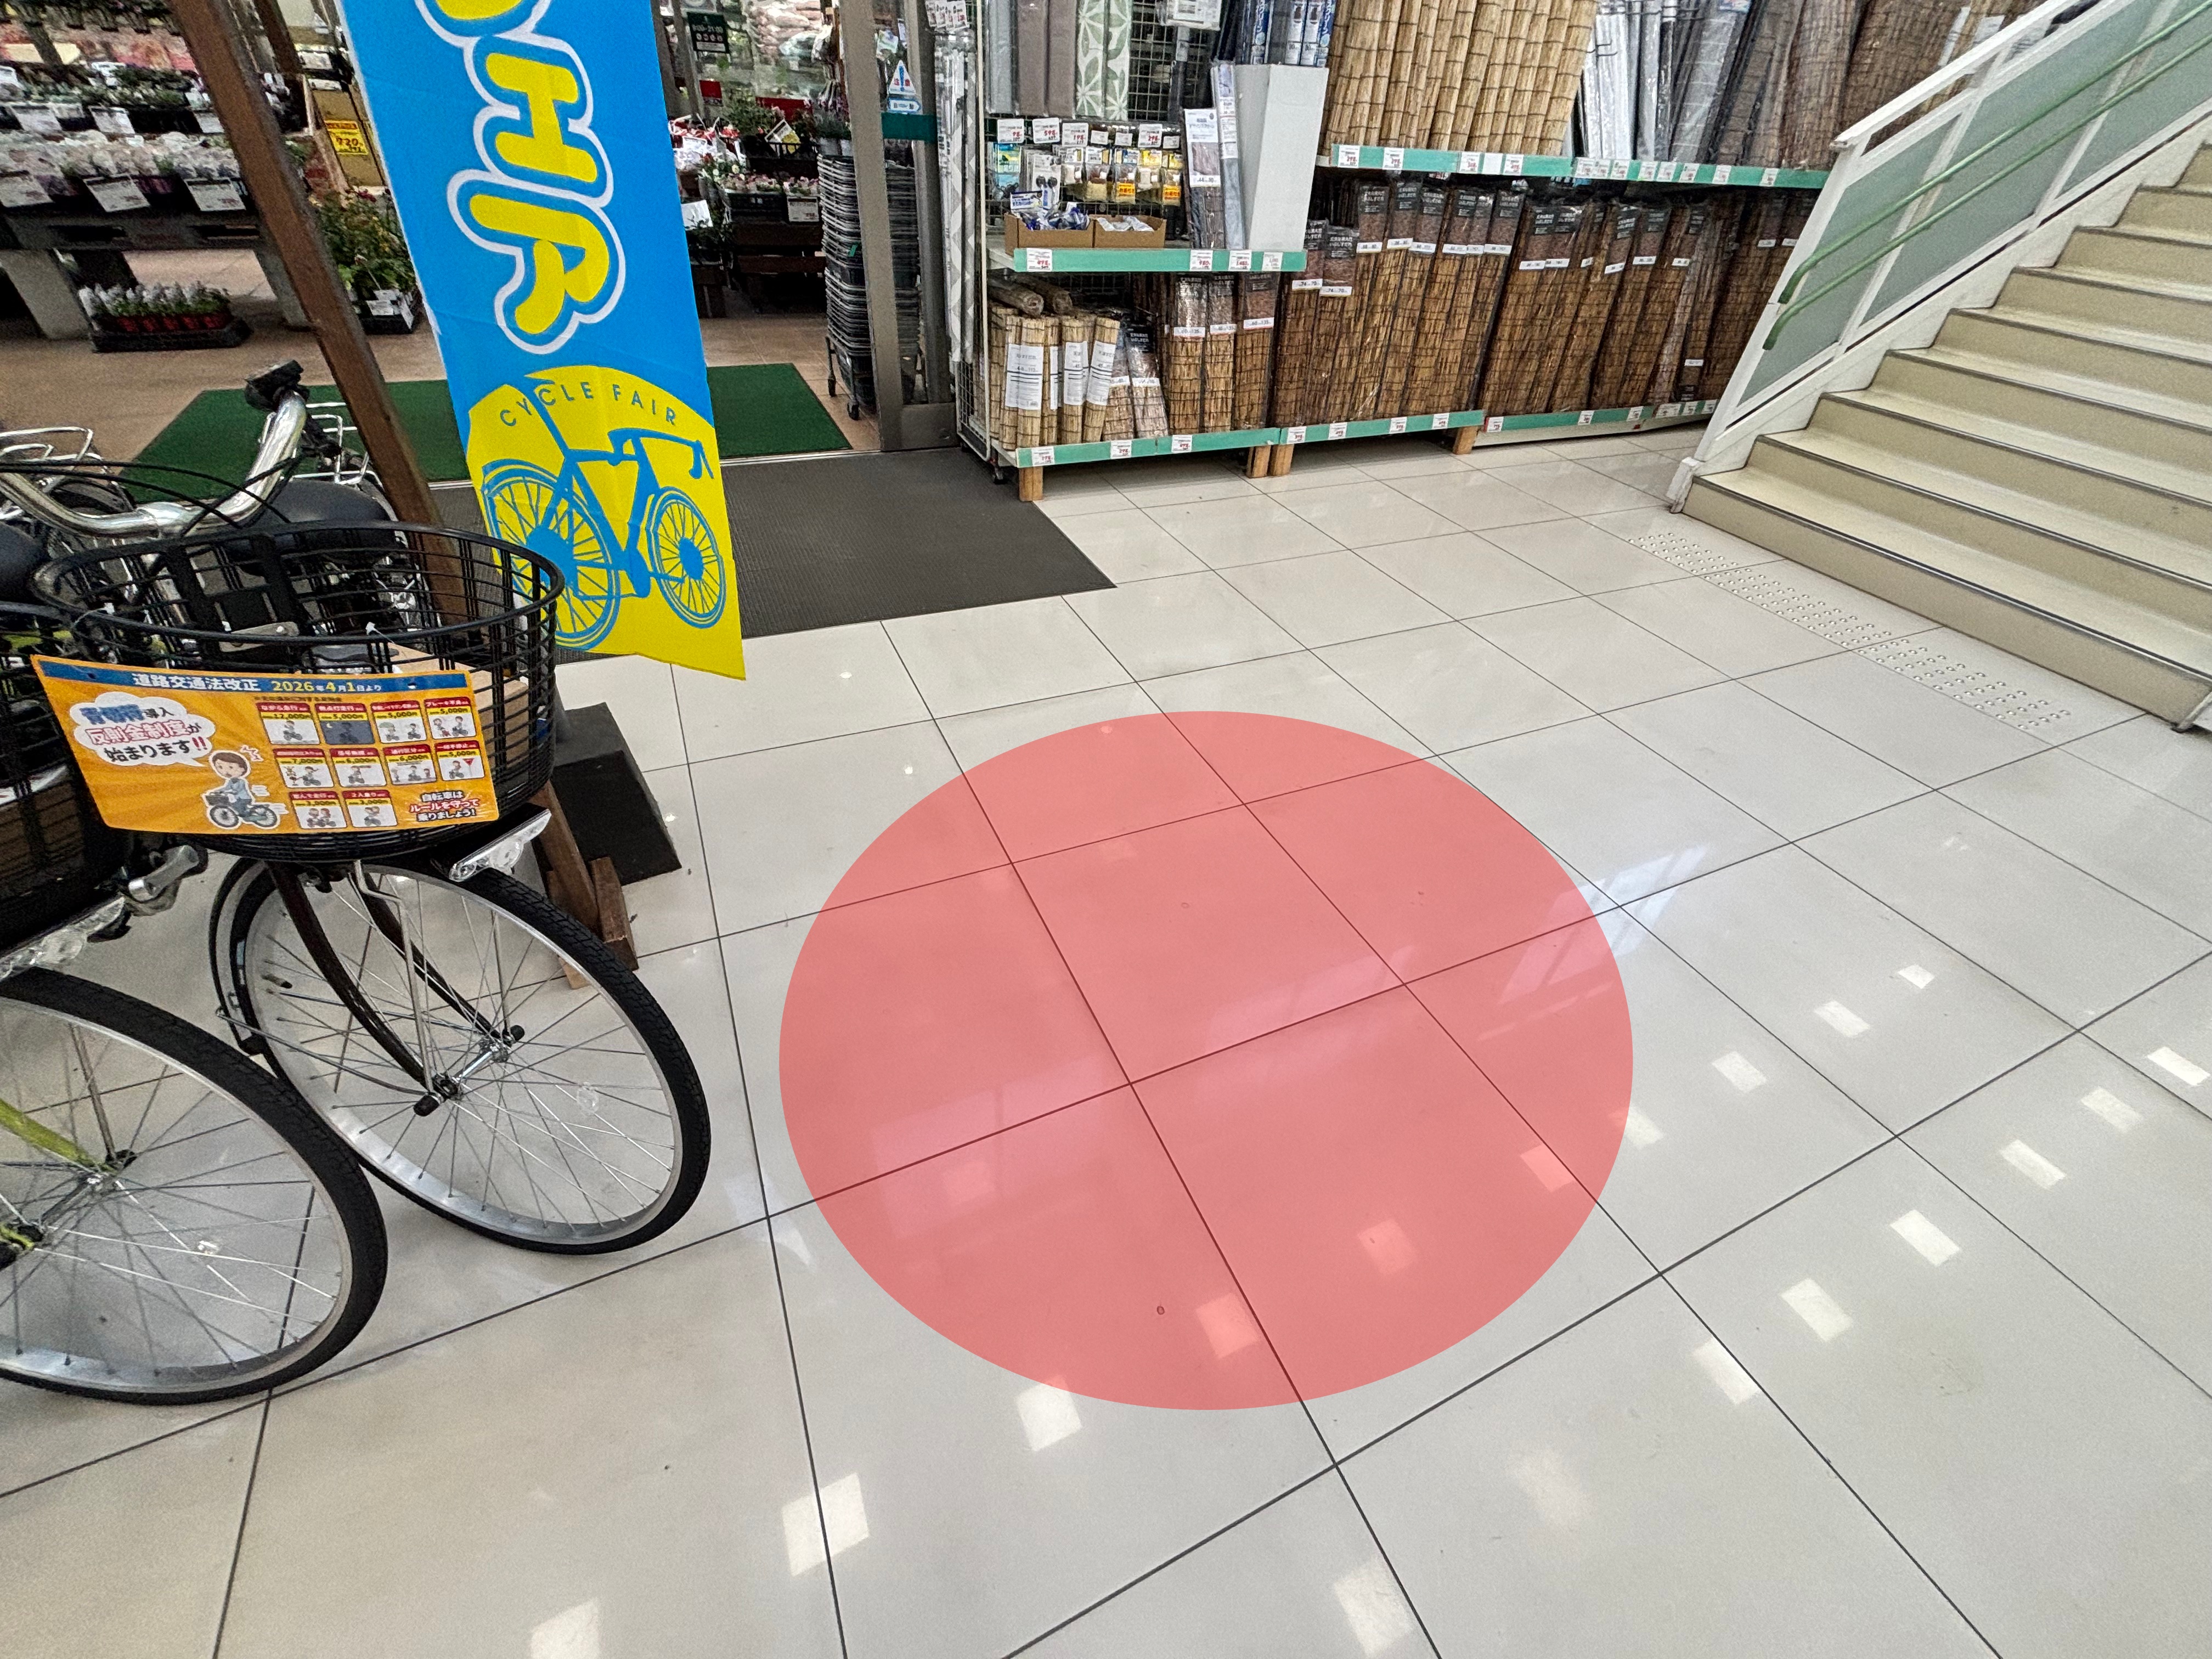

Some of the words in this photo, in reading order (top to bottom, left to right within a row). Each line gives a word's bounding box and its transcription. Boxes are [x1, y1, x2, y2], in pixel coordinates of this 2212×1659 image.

[500, 381, 594, 427] CYCLE
[613, 383, 677, 426] FAIR
[131, 673, 262, 692] 道路交通法改正
[85, 719, 202, 746] 反則金制度が
[409, 798, 481, 812] ルールを守って
[420, 790, 465, 802] 自転車は
